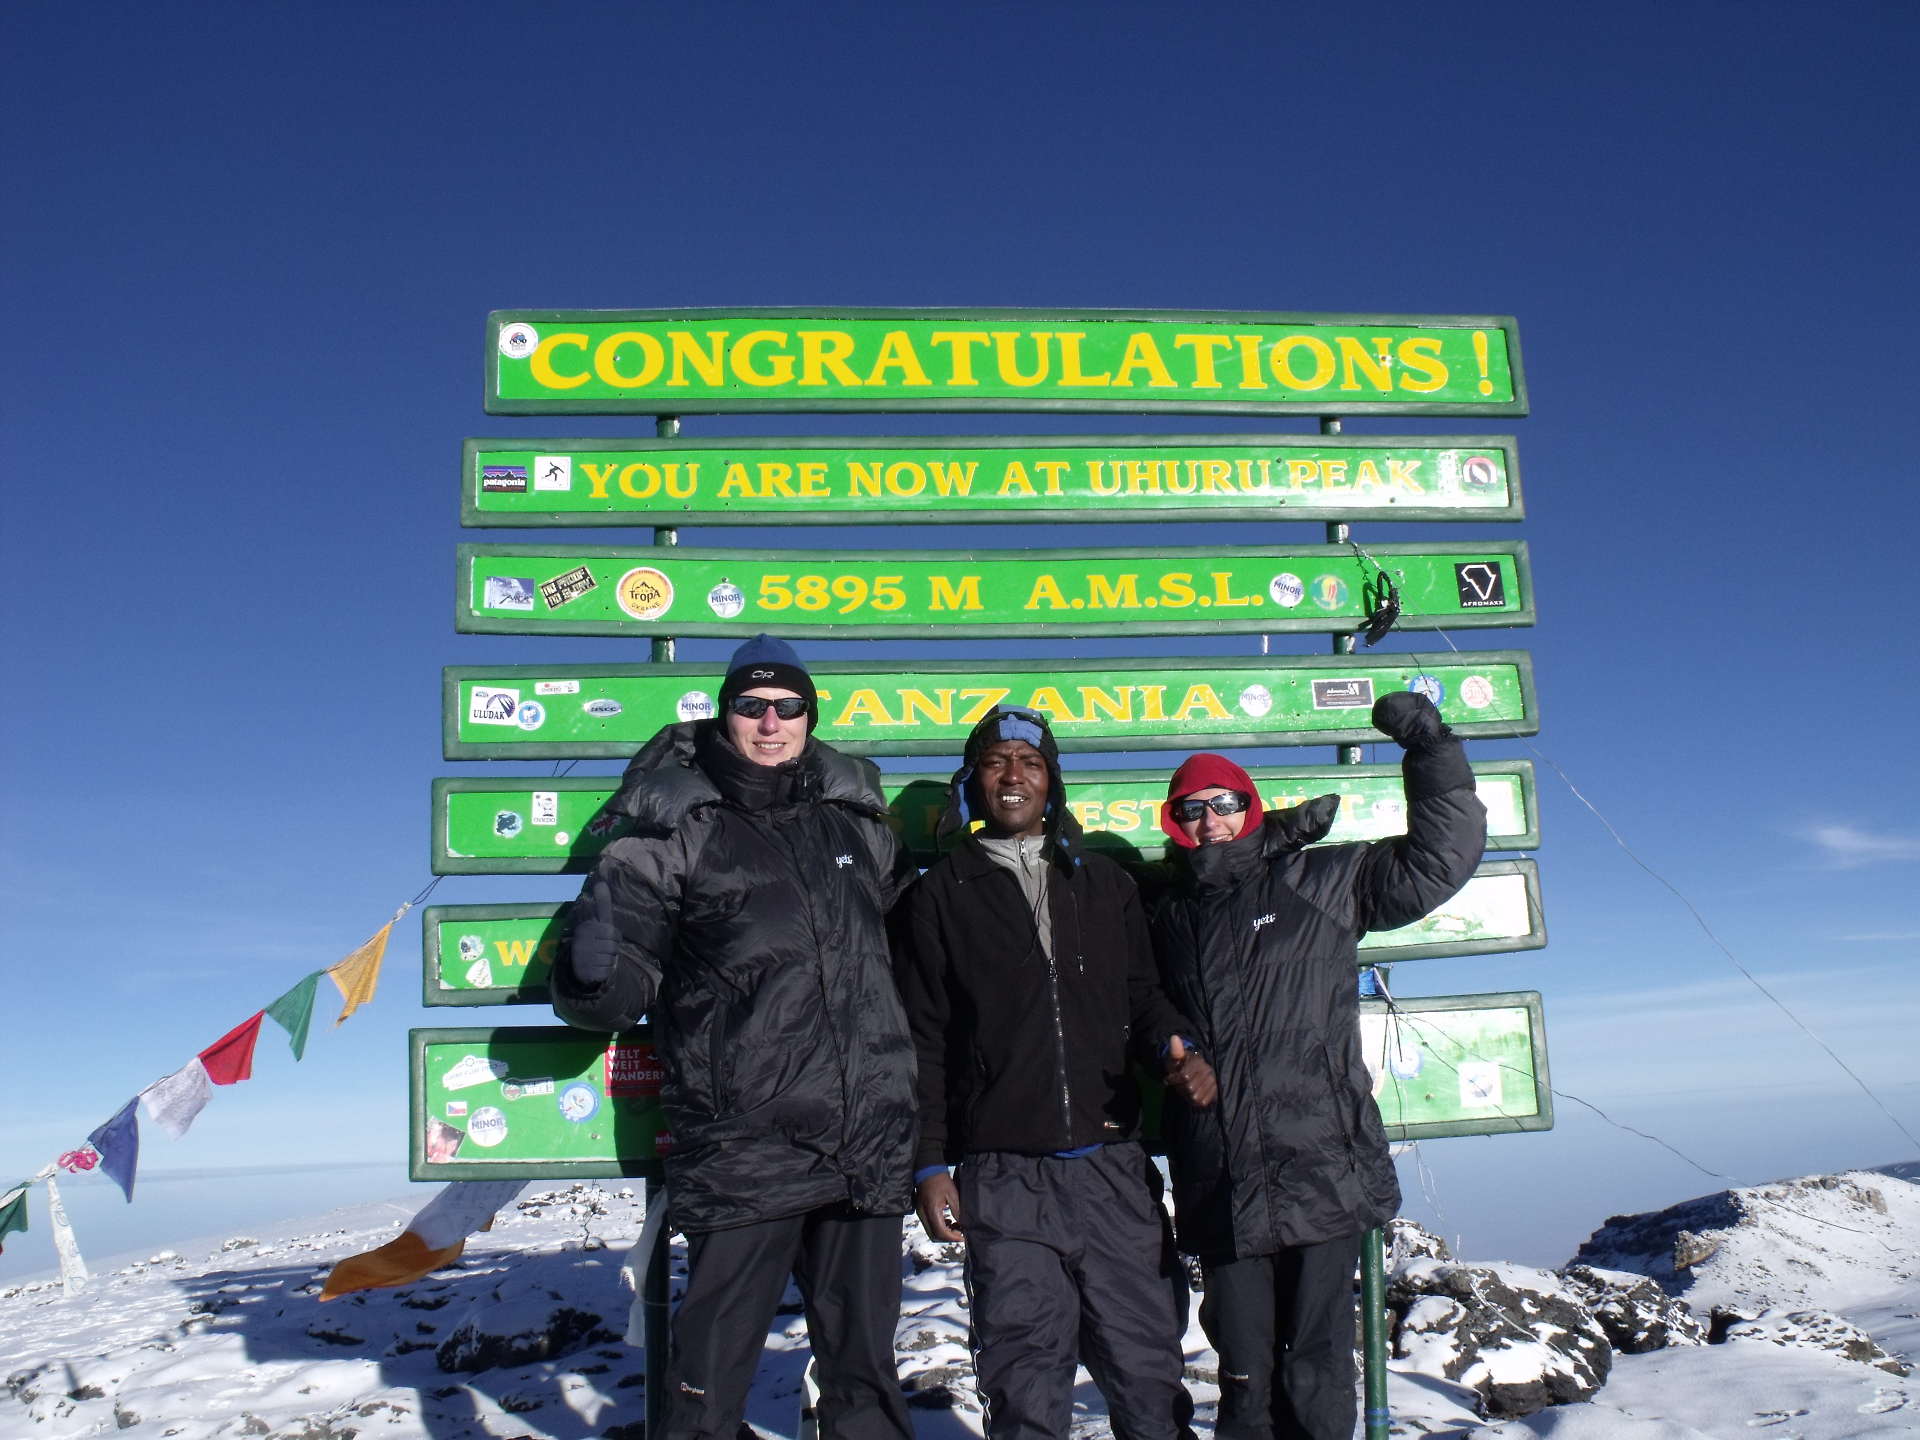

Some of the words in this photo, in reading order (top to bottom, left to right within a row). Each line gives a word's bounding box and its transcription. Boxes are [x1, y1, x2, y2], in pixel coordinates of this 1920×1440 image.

[530, 330, 1449, 392] CONGRATULATIONS
[1472, 330, 1493, 396] !
[483, 478, 526, 488] patagonia
[579, 463, 701, 499] YOU
[717, 463, 831, 498] ARE
[847, 462, 979, 497] NOW
[997, 461, 1070, 496] AT
[1086, 460, 1271, 496] UHURU
[1287, 459, 1426, 496] PEAK
[756, 575, 907, 614] 5895
[928, 576, 984, 610] M
[1023, 572, 1264, 609] A.M.S.L.
[1273, 580, 1301, 597] MINOR
[711, 593, 740, 604] MINOR
[751, 670, 775, 679] OR
[681, 702, 711, 712] MINOR
[816, 684, 1234, 725] ANZANIA
[836, 854, 853, 869] yeti
[1253, 913, 1276, 931] yeti
[608, 1049, 640, 1060] WELT
[608, 1060, 640, 1070] WEIT
[471, 1118, 504, 1130] MINOR
